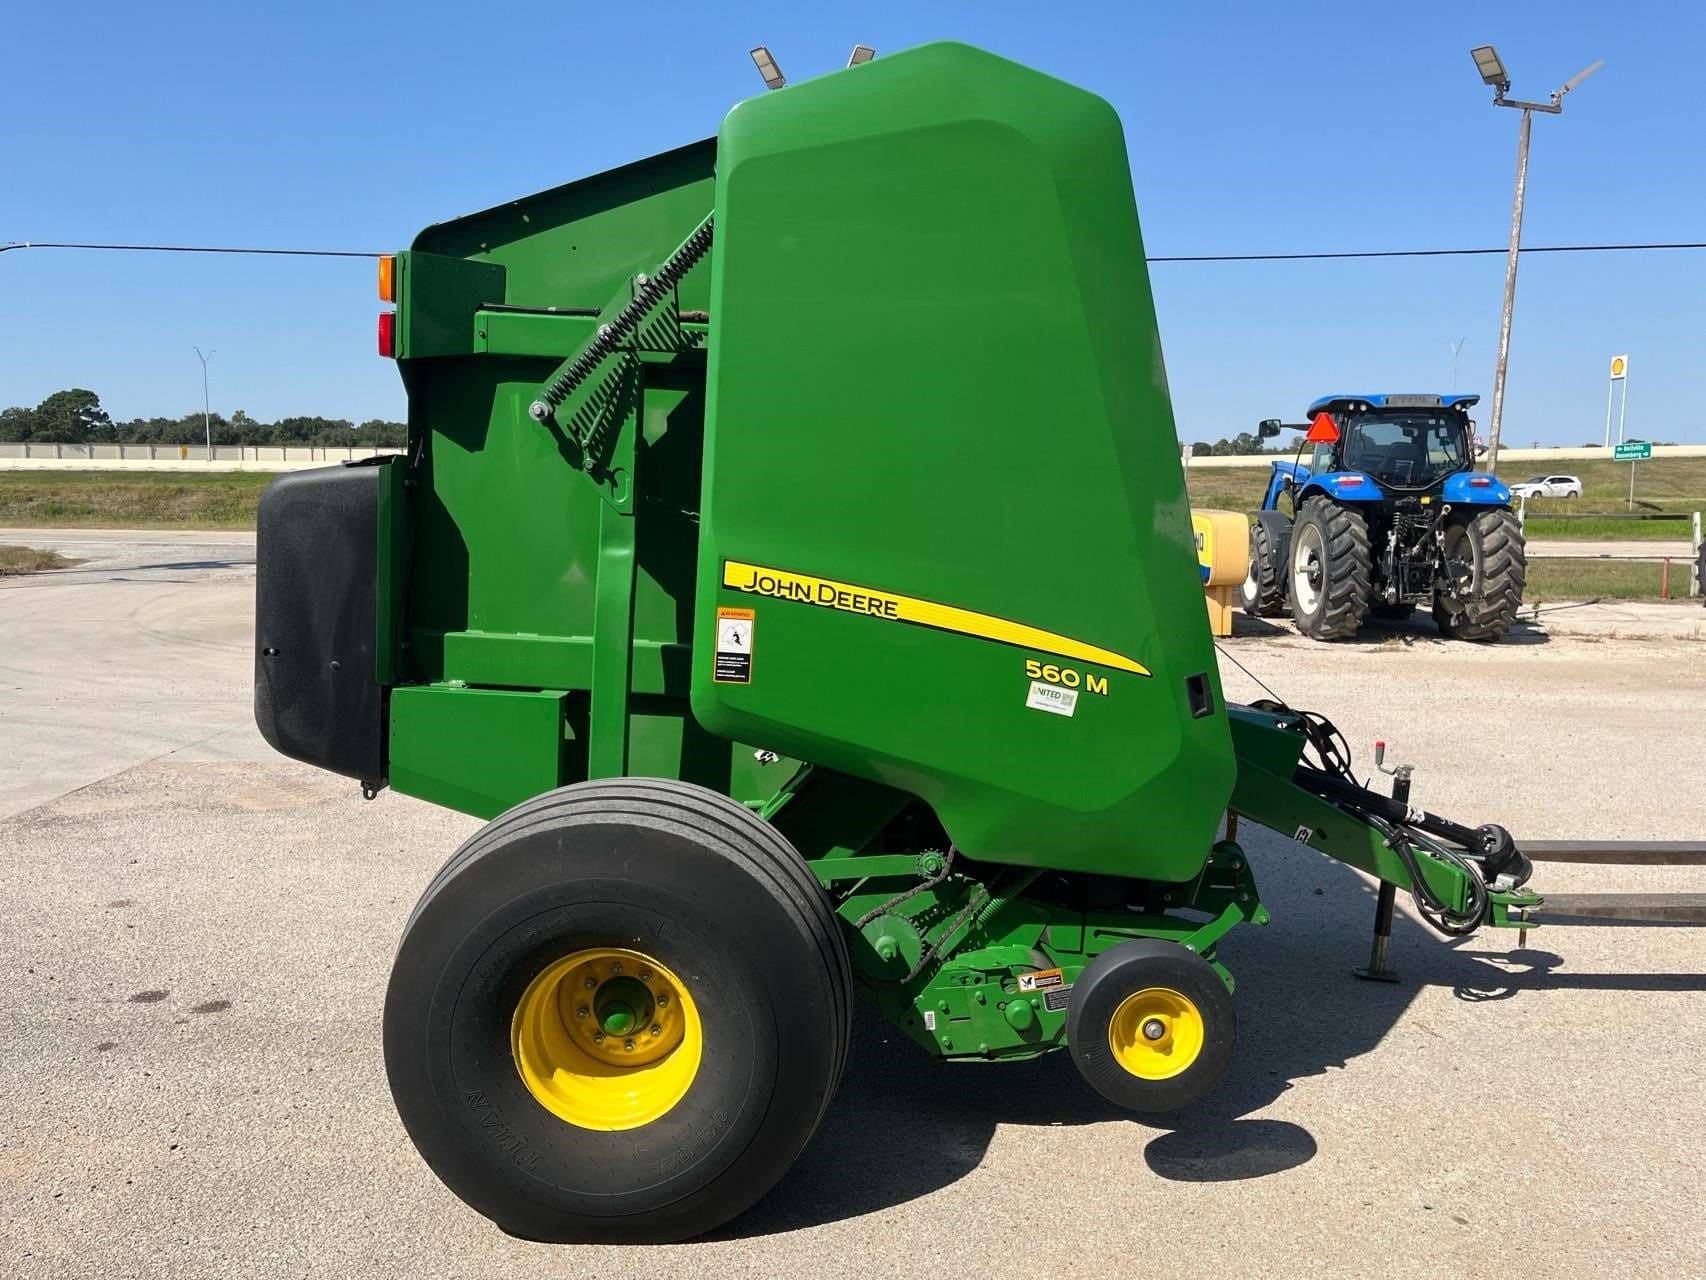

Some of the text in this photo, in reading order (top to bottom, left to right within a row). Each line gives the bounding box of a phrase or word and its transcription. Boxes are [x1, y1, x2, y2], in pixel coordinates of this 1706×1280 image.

[744, 571, 898, 617] JOHN DEERE
[1025, 659, 1109, 696] 560 M
